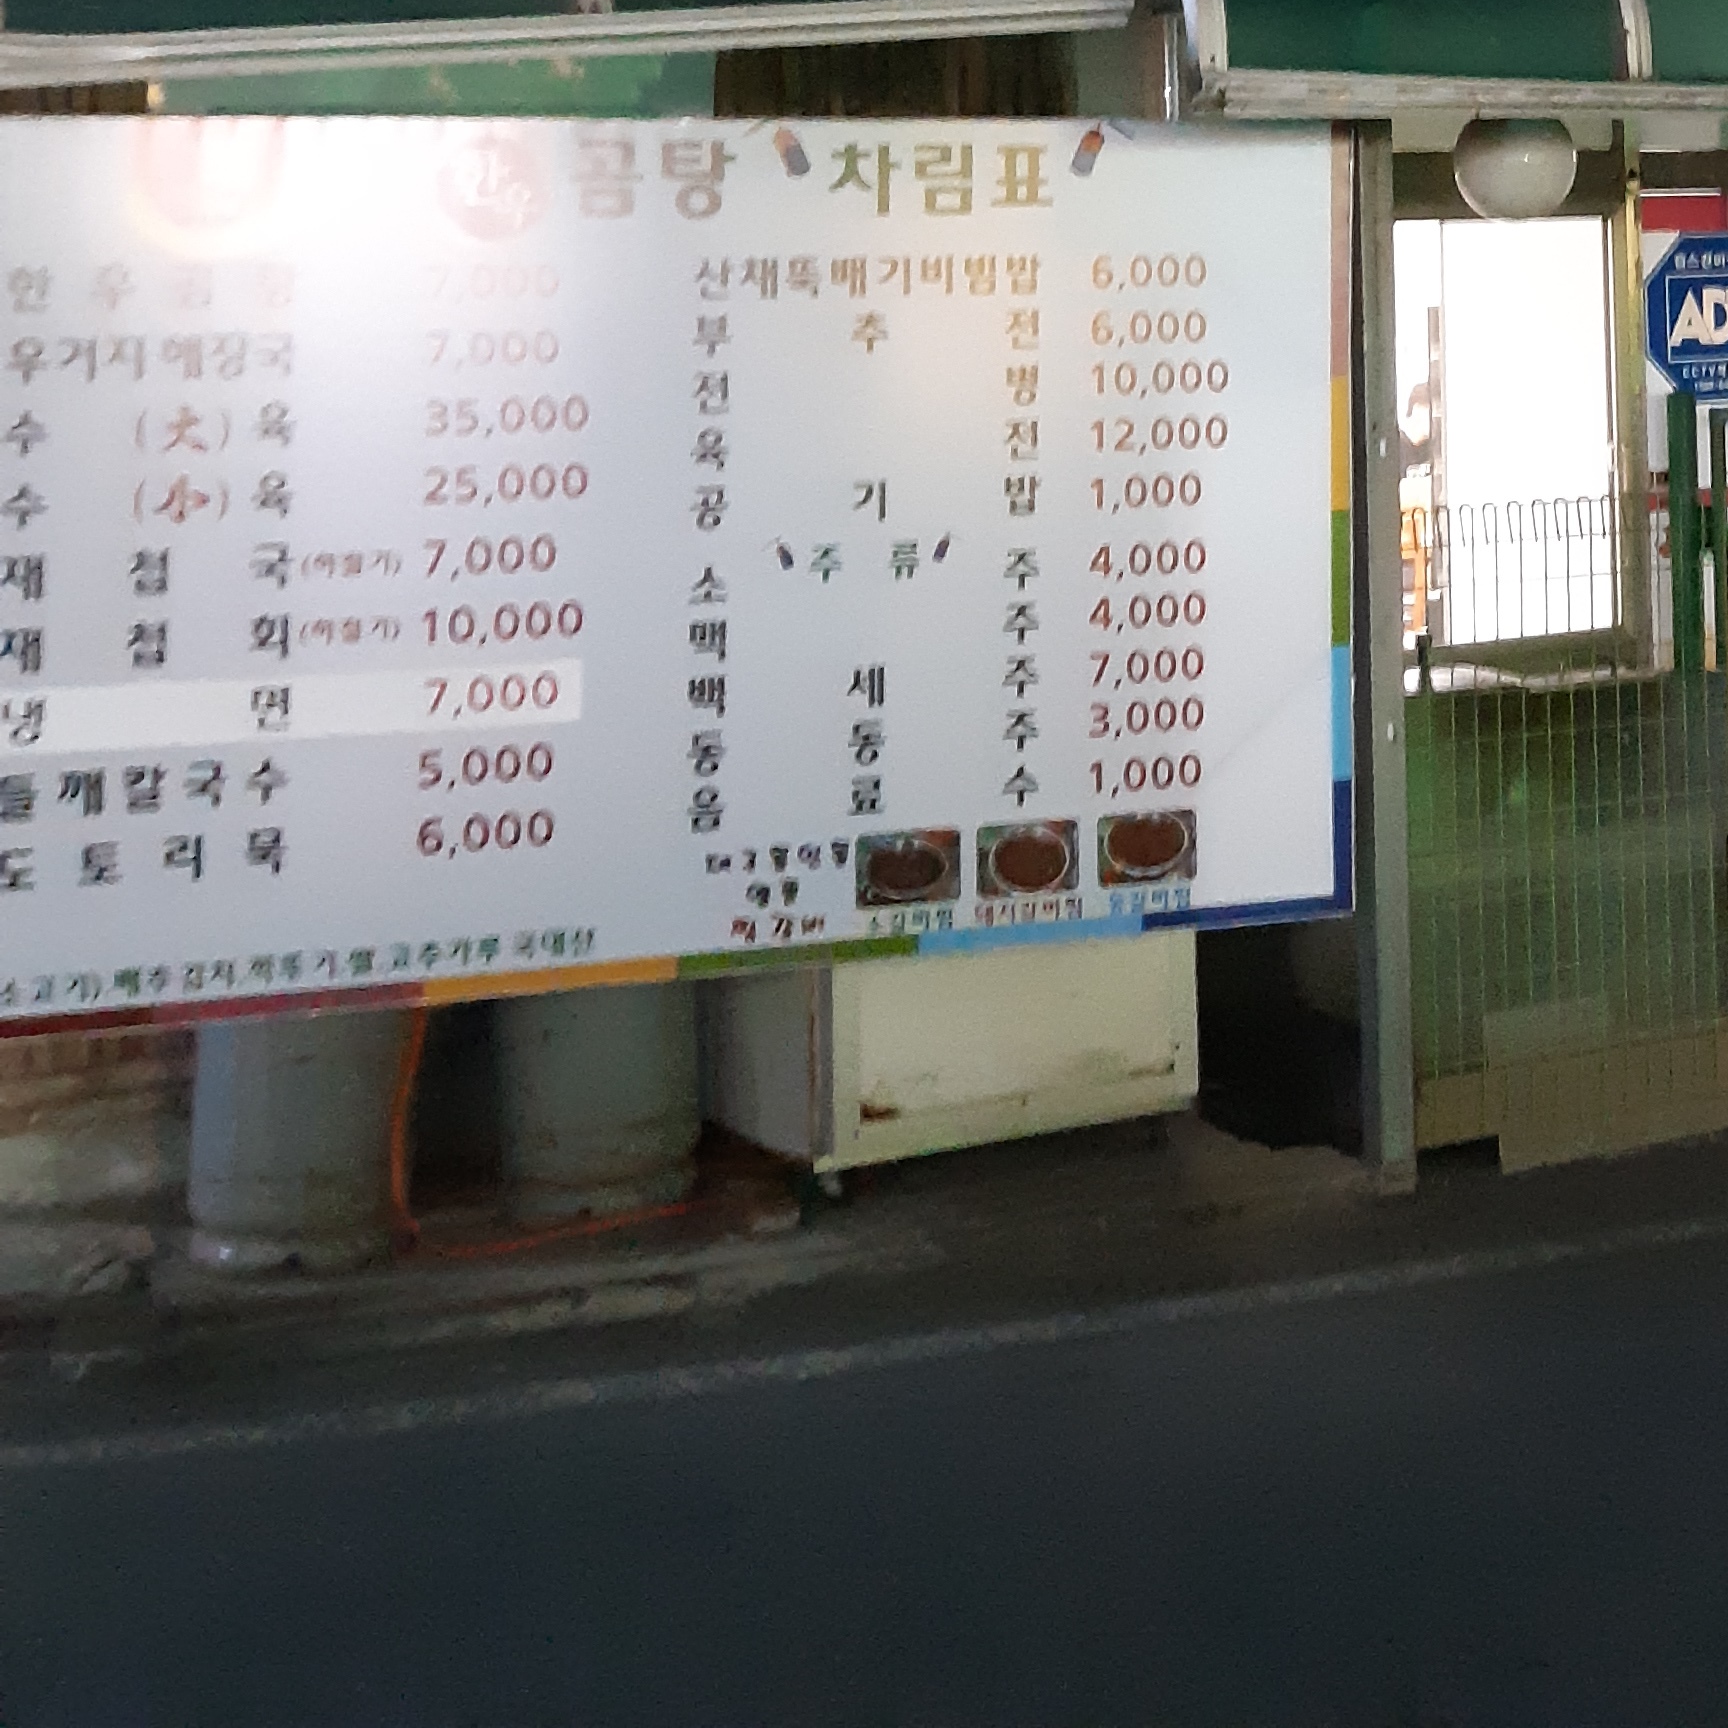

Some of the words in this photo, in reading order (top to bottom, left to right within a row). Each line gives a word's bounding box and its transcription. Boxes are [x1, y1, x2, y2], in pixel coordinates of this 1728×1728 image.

[574, 136, 736, 220] 곰탕
[829, 138, 1053, 217] 차림표
[1091, 253, 1207, 296] 6,000
[424, 329, 560, 372] 7,000
[1091, 307, 1207, 349] 6,000
[1090, 357, 1229, 399] 10,000
[424, 394, 589, 440] 35,000
[1090, 414, 1229, 456] 12,000
[423, 462, 588, 509] 25,000
[1090, 470, 1203, 515] 1,000
[424, 535, 557, 581] 7,000
[1089, 537, 1207, 580] 4,000
[423, 599, 584, 646] 10,000
[1089, 590, 1207, 634] 4,000
[1089, 645, 1205, 692] 7,000
[425, 670, 559, 718] 7,000
[1089, 695, 1205, 741] 3,000
[418, 741, 554, 790] 5,000
[1089, 752, 1202, 798] 1,000
[416, 809, 554, 858] 6,000
